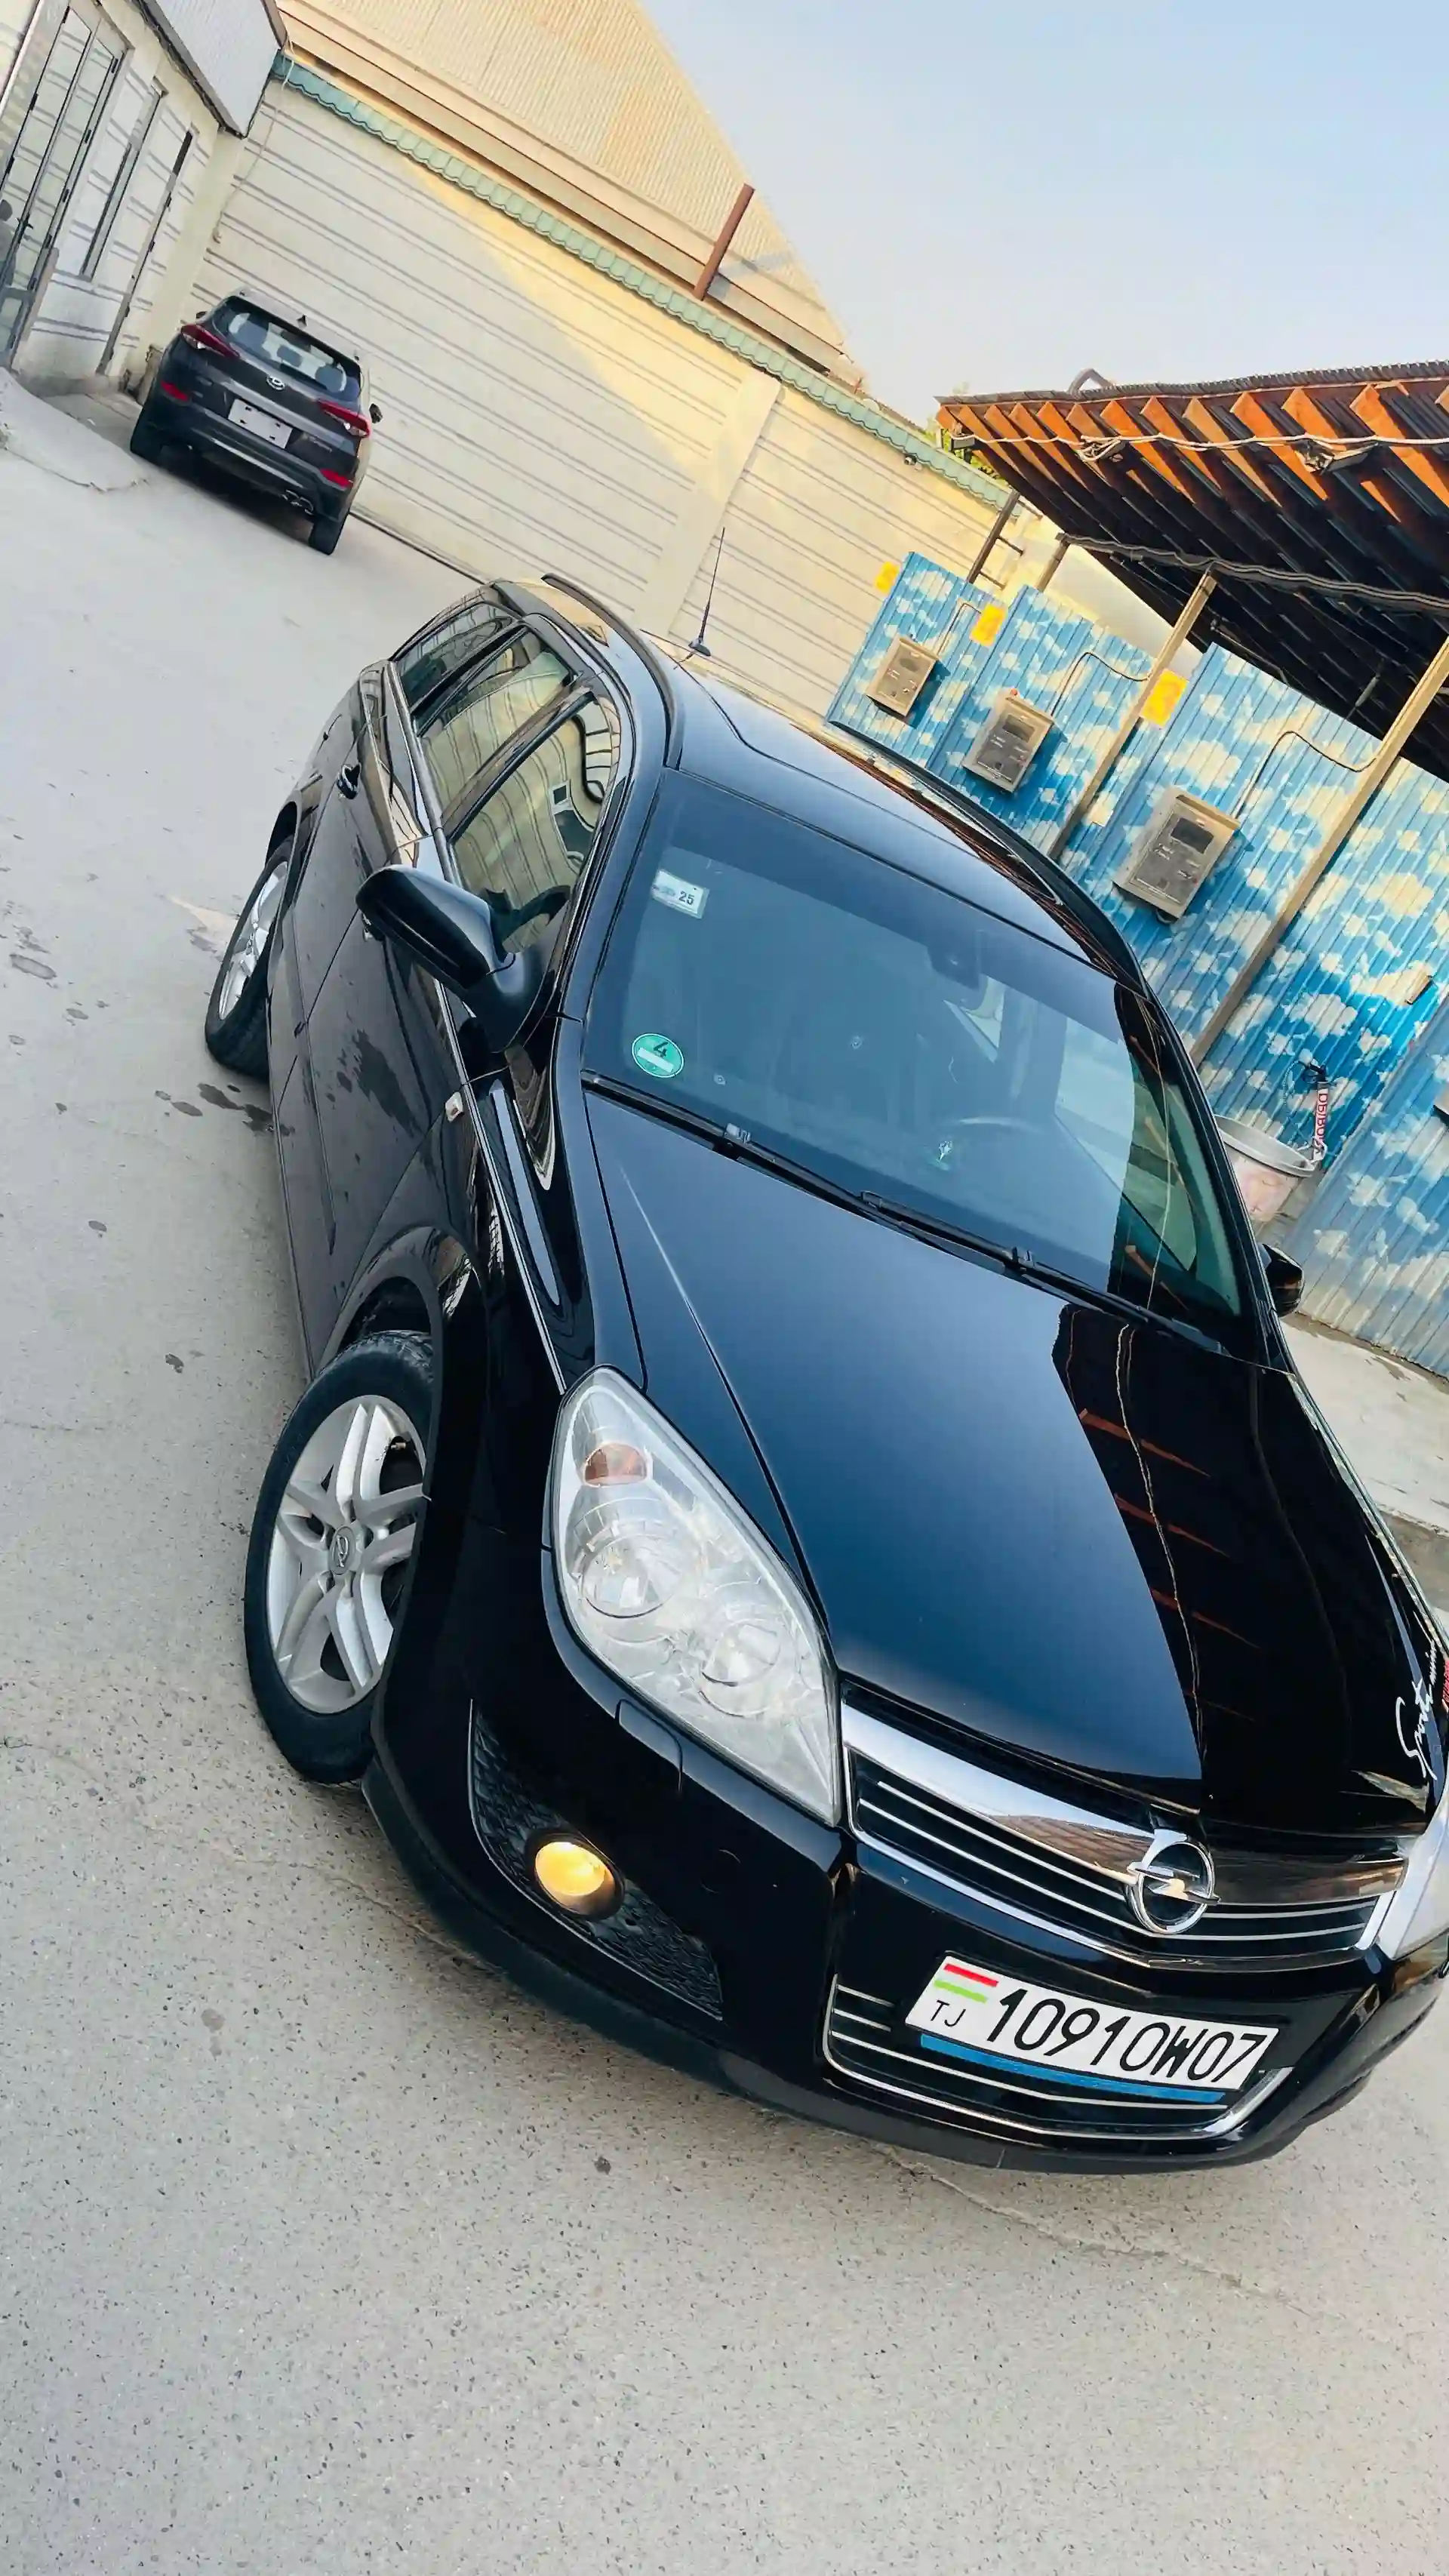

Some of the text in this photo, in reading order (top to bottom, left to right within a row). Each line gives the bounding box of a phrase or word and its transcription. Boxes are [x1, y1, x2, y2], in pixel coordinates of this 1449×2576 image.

[678, 891, 695, 906] 25
[653, 1041, 669, 1059] 4
[930, 1999, 967, 2028] TJ
